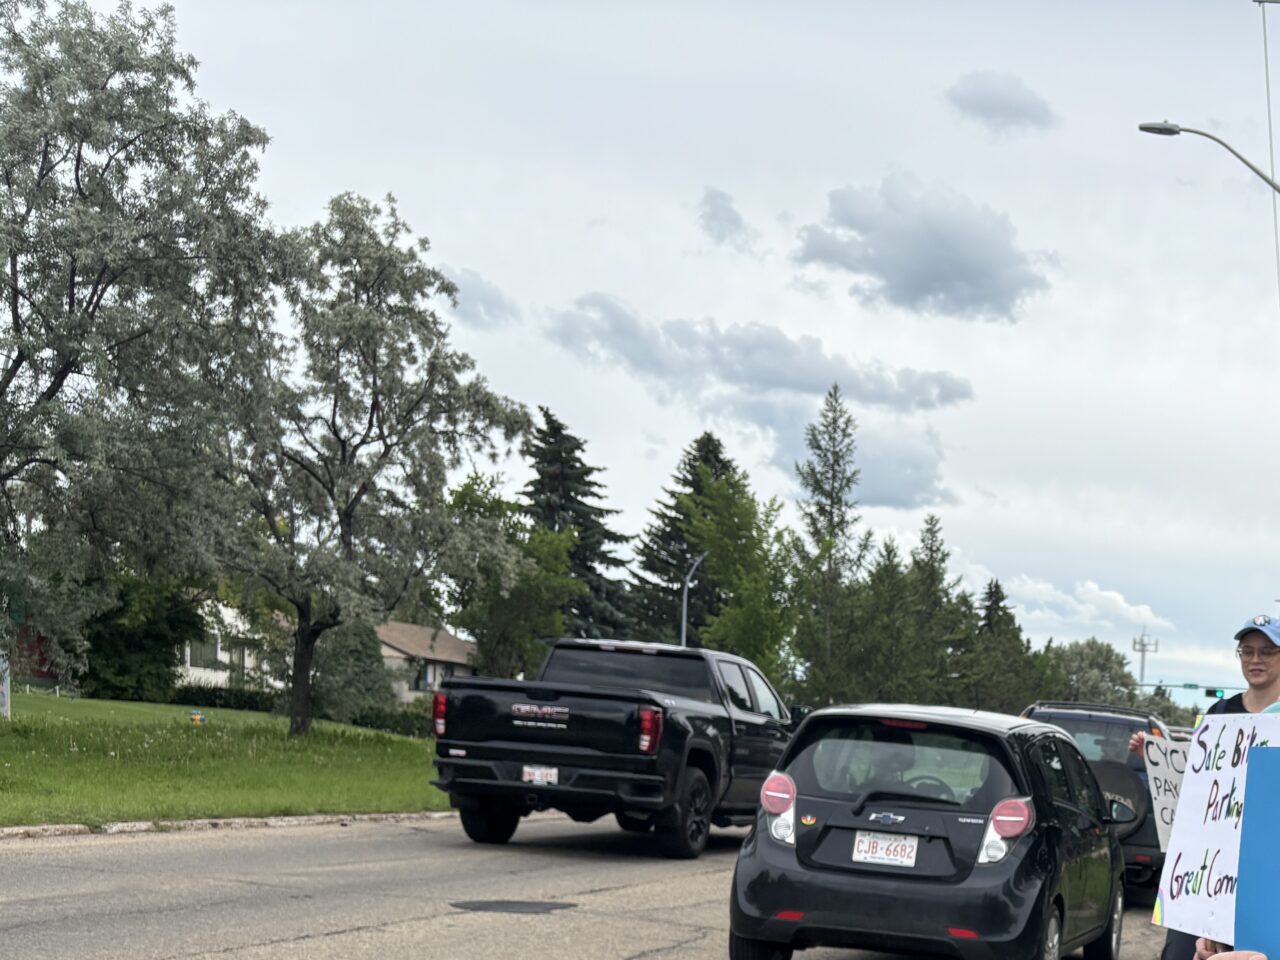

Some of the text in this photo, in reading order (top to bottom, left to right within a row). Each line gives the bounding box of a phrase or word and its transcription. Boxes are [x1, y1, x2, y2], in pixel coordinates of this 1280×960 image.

[1191, 723, 1269, 774] Safe Bik
[1203, 777, 1244, 830] Parking
[1169, 847, 1209, 900] Great
